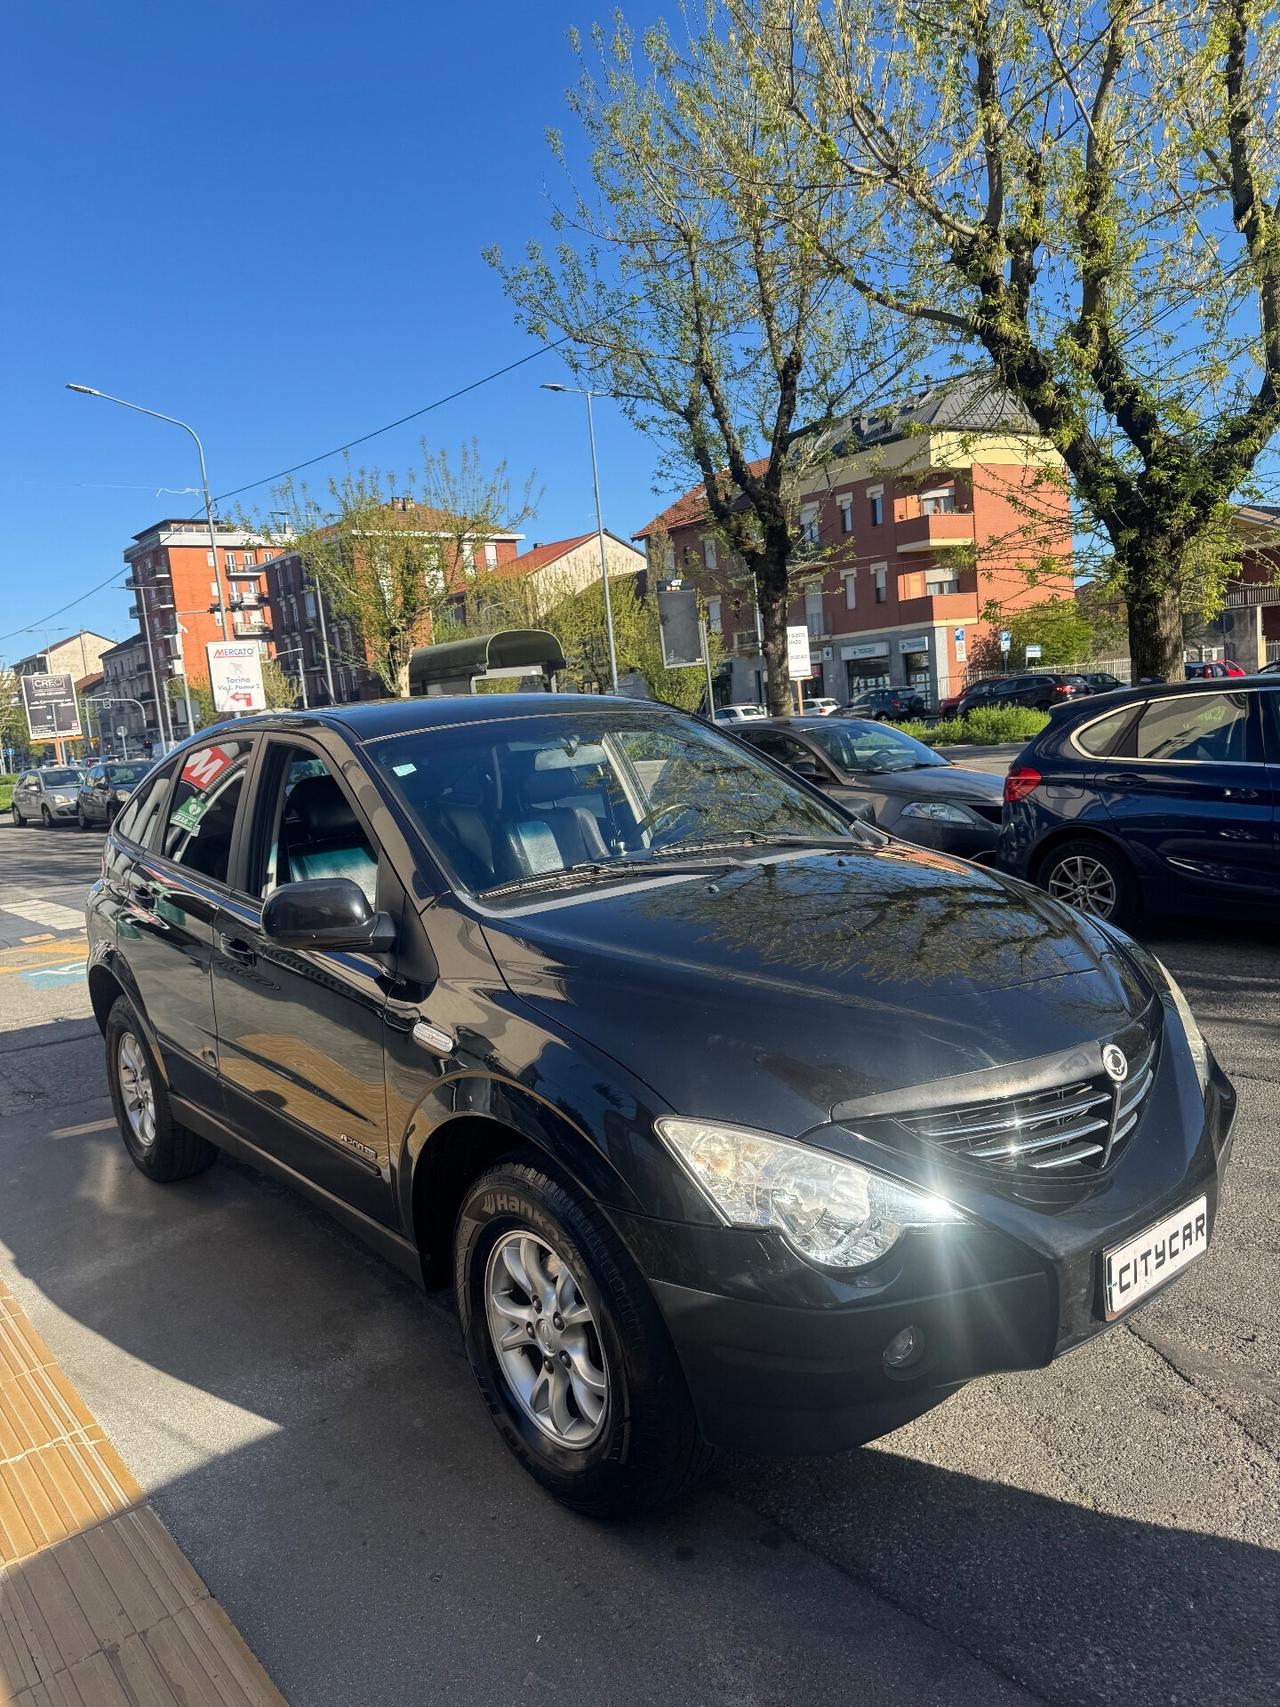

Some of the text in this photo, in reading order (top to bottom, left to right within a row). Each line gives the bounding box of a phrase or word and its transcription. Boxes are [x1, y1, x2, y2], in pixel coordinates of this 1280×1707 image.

[34, 678, 63, 688] CREO
[226, 676, 251, 684] Torino
[1118, 1212, 1205, 1294] CITYCAR
